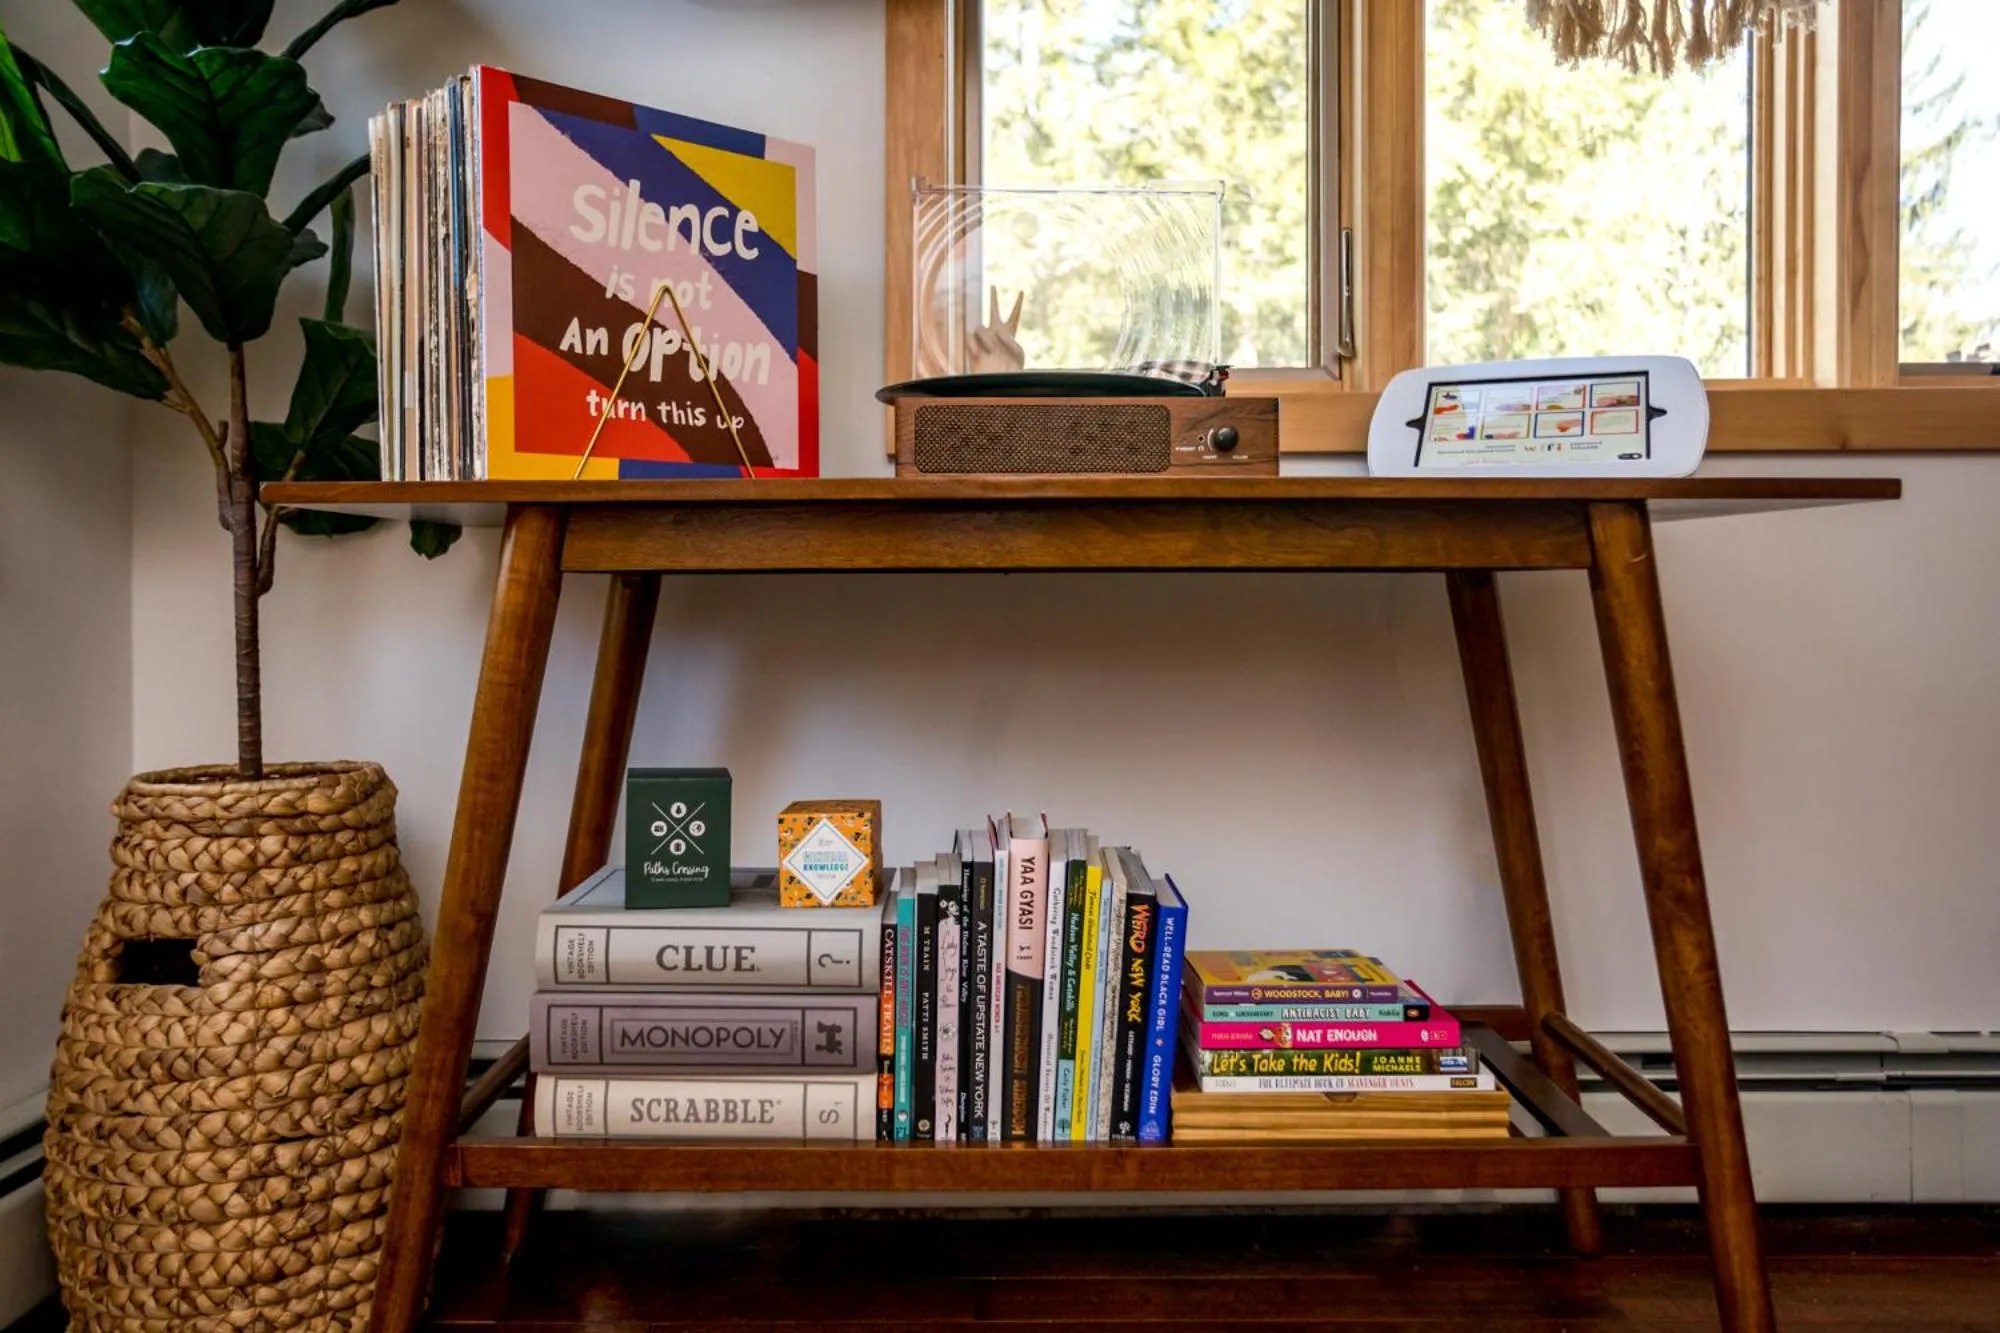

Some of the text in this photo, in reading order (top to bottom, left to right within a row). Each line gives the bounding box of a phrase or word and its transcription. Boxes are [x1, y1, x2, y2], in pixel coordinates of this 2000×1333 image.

[569, 179, 760, 261] Silence
[604, 264, 714, 310] is not
[559, 316, 609, 356] An
[586, 388, 745, 432] turn this up
[643, 860, 710, 879] Paths Crossing
[803, 863, 849, 871] KNOWLEDGE
[1018, 856, 1035, 930] YAA GYASI
[1069, 912, 1081, 942] Hudson
[1128, 904, 1151, 953] WEIRD
[567, 937, 576, 975] VINTAGE
[655, 943, 756, 973] CLUE
[923, 925, 931, 971] M TRAIN
[1048, 887, 1061, 1000] Gathering Woodstock Women
[1066, 944, 1079, 968] Valley
[1067, 968, 1076, 976] &
[1128, 957, 1146, 988] NEW
[1156, 917, 1175, 1031] WELL-READ BLACK GIRL
[882, 928, 895, 1055] CATSKILL TRAILS
[960, 981, 969, 1003] Valley
[1065, 977, 1076, 1012] Catskills
[1127, 991, 1144, 1023] YORK
[1324, 989, 1349, 998] BABY!
[922, 991, 930, 1060] PATTI SMITH
[973, 921, 987, 1119] A TASTE OF UPSTATE NEW YORK
[1280, 1008, 1370, 1019] ANTIRACIST BABY
[619, 1025, 786, 1049] MONOPOLY
[1296, 1029, 1378, 1042] NAT ENOUGH
[1212, 1051, 1361, 1074] Let's Take the Kids!
[1372, 1055, 1422, 1064] JOANNE
[1372, 1064, 1422, 1072] MICHAELS
[1148, 1054, 1162, 1114] GLORY EDIM
[630, 1096, 776, 1125] SCRABBLE
[1011, 1078, 1028, 1136] KINGDOM
